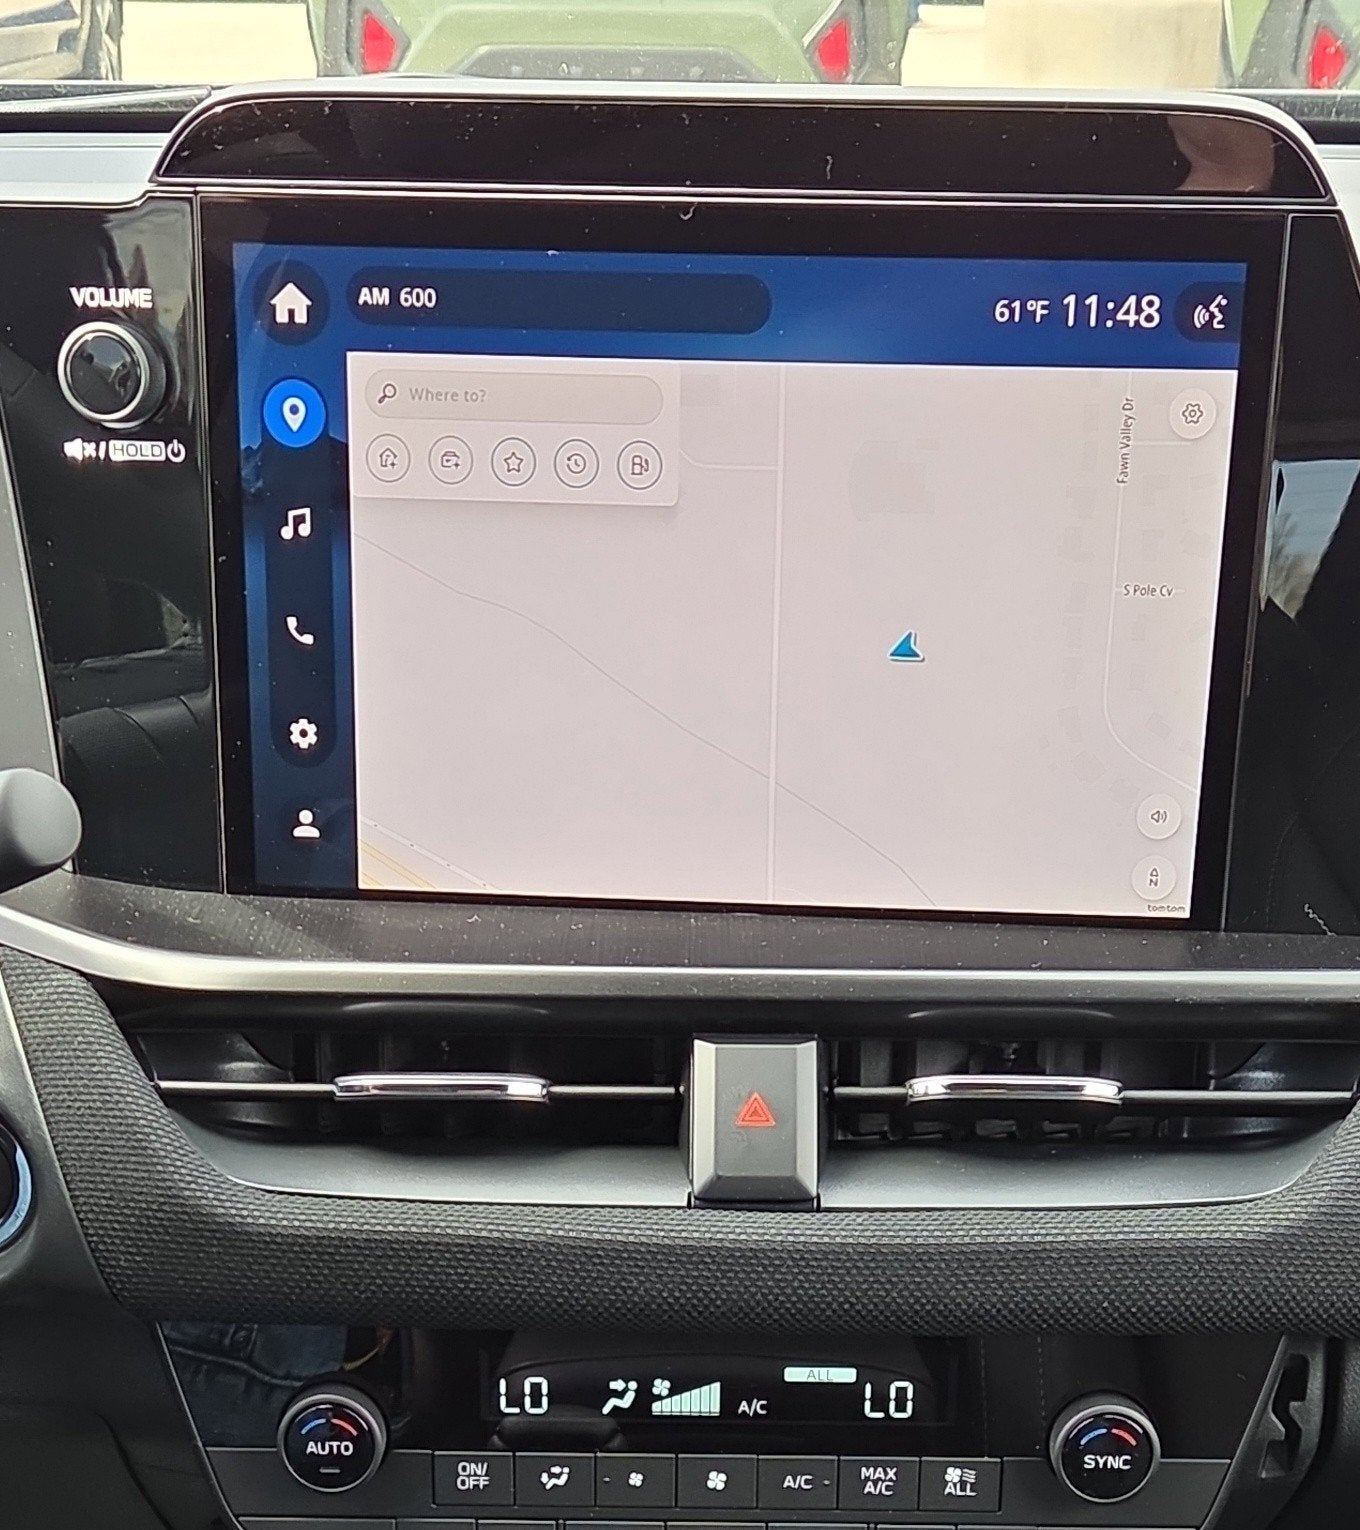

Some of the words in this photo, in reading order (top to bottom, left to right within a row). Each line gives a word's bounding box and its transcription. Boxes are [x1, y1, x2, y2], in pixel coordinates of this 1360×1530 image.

[69, 286, 153, 309] VOLUME
[358, 286, 390, 306] AM
[399, 287, 437, 308] 600
[1062, 294, 1161, 328] 11:48
[408, 387, 459, 402] Where
[463, 387, 487, 403] to?
[1121, 397, 1134, 412] Dr
[1119, 414, 1136, 450] Valley
[112, 442, 163, 460] HOLD
[1116, 451, 1130, 484] Fawn
[1133, 584, 1157, 597] Pole
[1160, 585, 1173, 597] Cv
[806, 1369, 833, 1381] ALL
[738, 1399, 768, 1416] A/C
[306, 1441, 354, 1456] AUTO
[457, 1461, 488, 1476] ON/
[1083, 1454, 1132, 1472] SYNC
[861, 1466, 897, 1481] MAX
[456, 1476, 489, 1491] OFF
[783, 1475, 814, 1490] A/C
[864, 1481, 895, 1496] A/C
[944, 1481, 978, 1496] ALL
